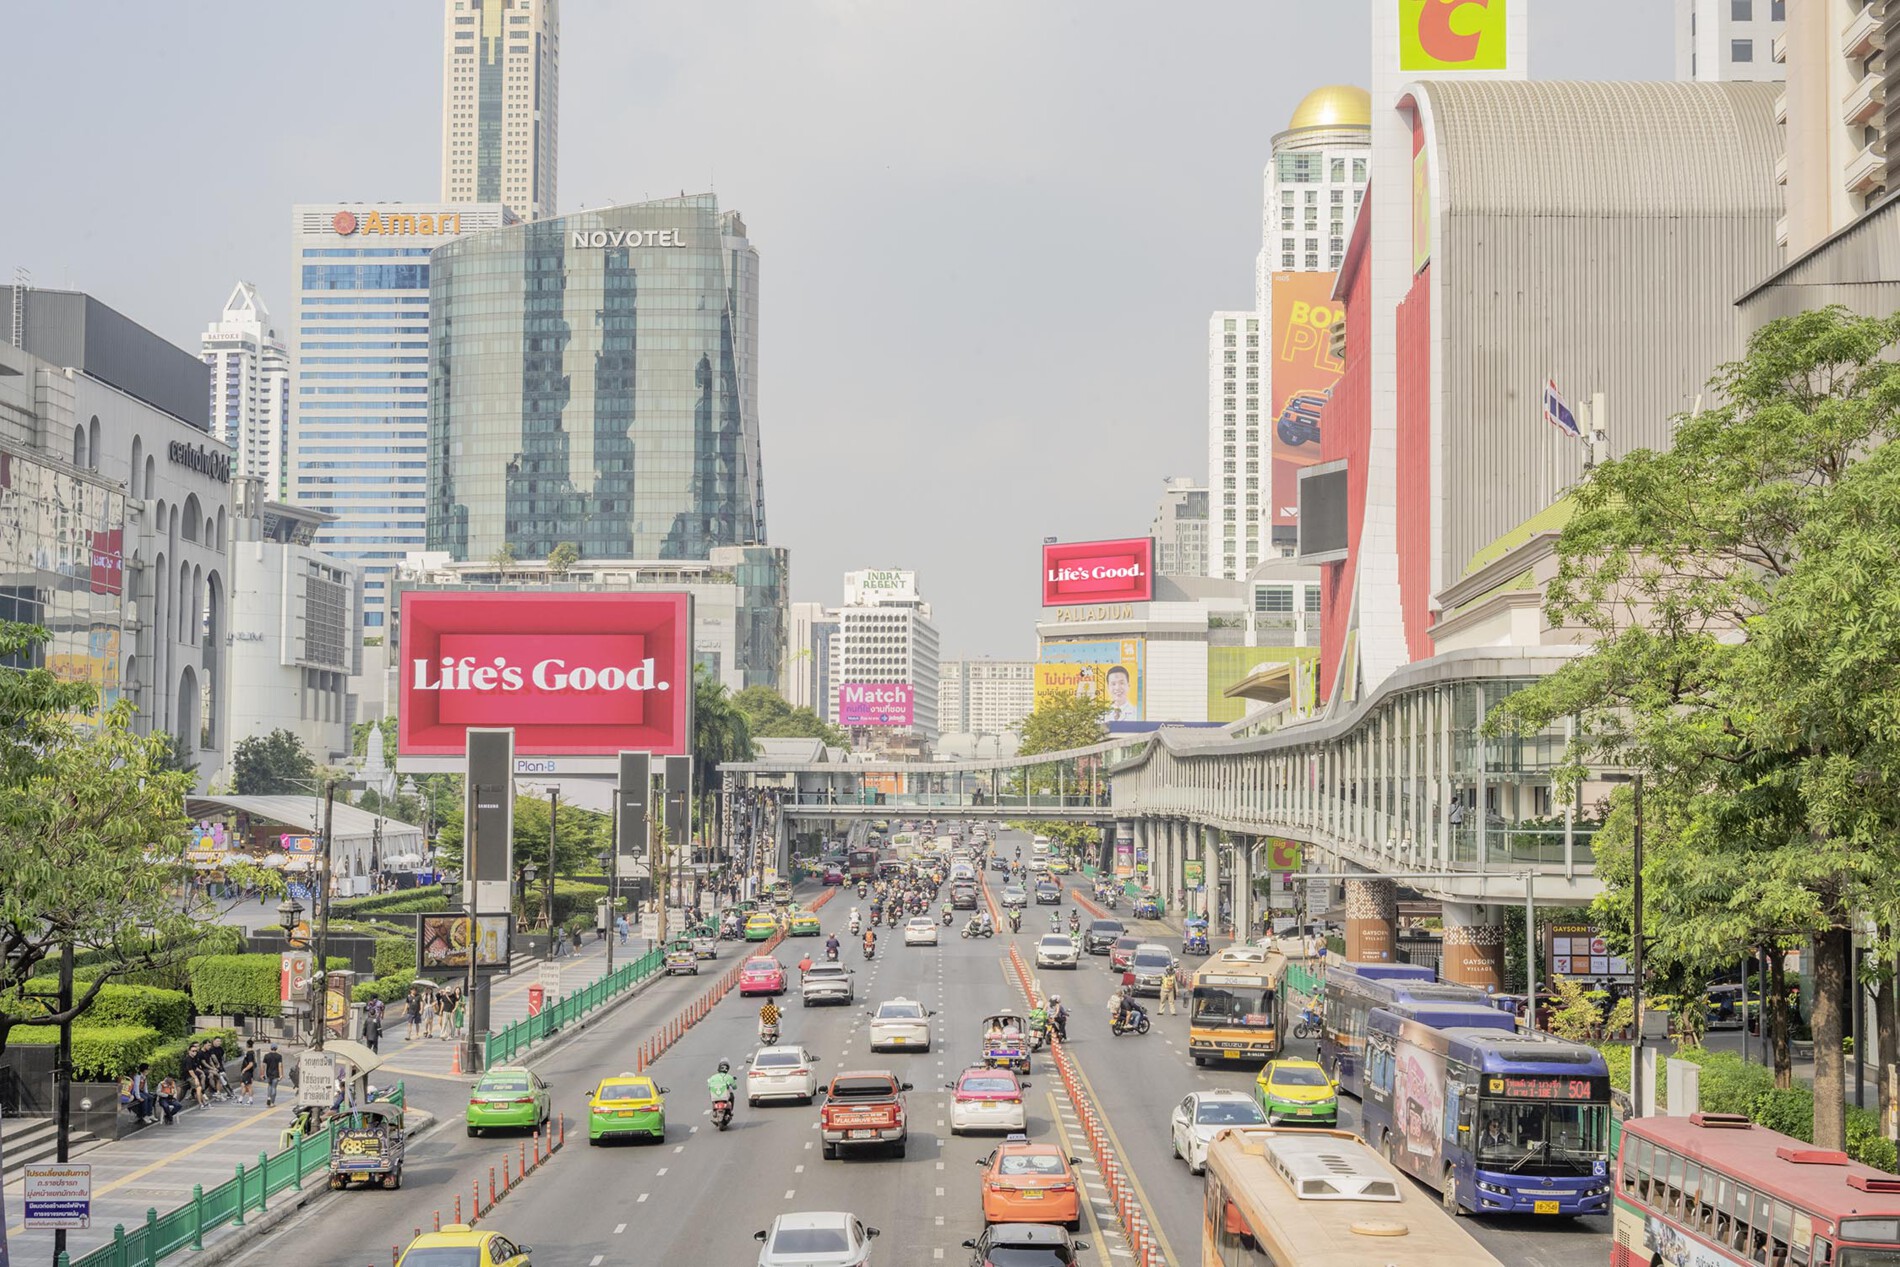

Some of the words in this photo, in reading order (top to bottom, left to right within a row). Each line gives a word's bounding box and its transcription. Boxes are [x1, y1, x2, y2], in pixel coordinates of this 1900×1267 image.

[361, 210, 461, 235] Amari
[572, 228, 686, 248] NOVOTEL
[867, 572, 901, 580] INDRA
[1048, 566, 1090, 582] Life's
[1092, 563, 1145, 579] Good.
[863, 580, 907, 589] REGENT
[1056, 604, 1134, 622] PALLADIUM
[413, 656, 524, 691] Life's
[532, 657, 670, 691] Good.
[1569, 1080, 1591, 1099] 504
